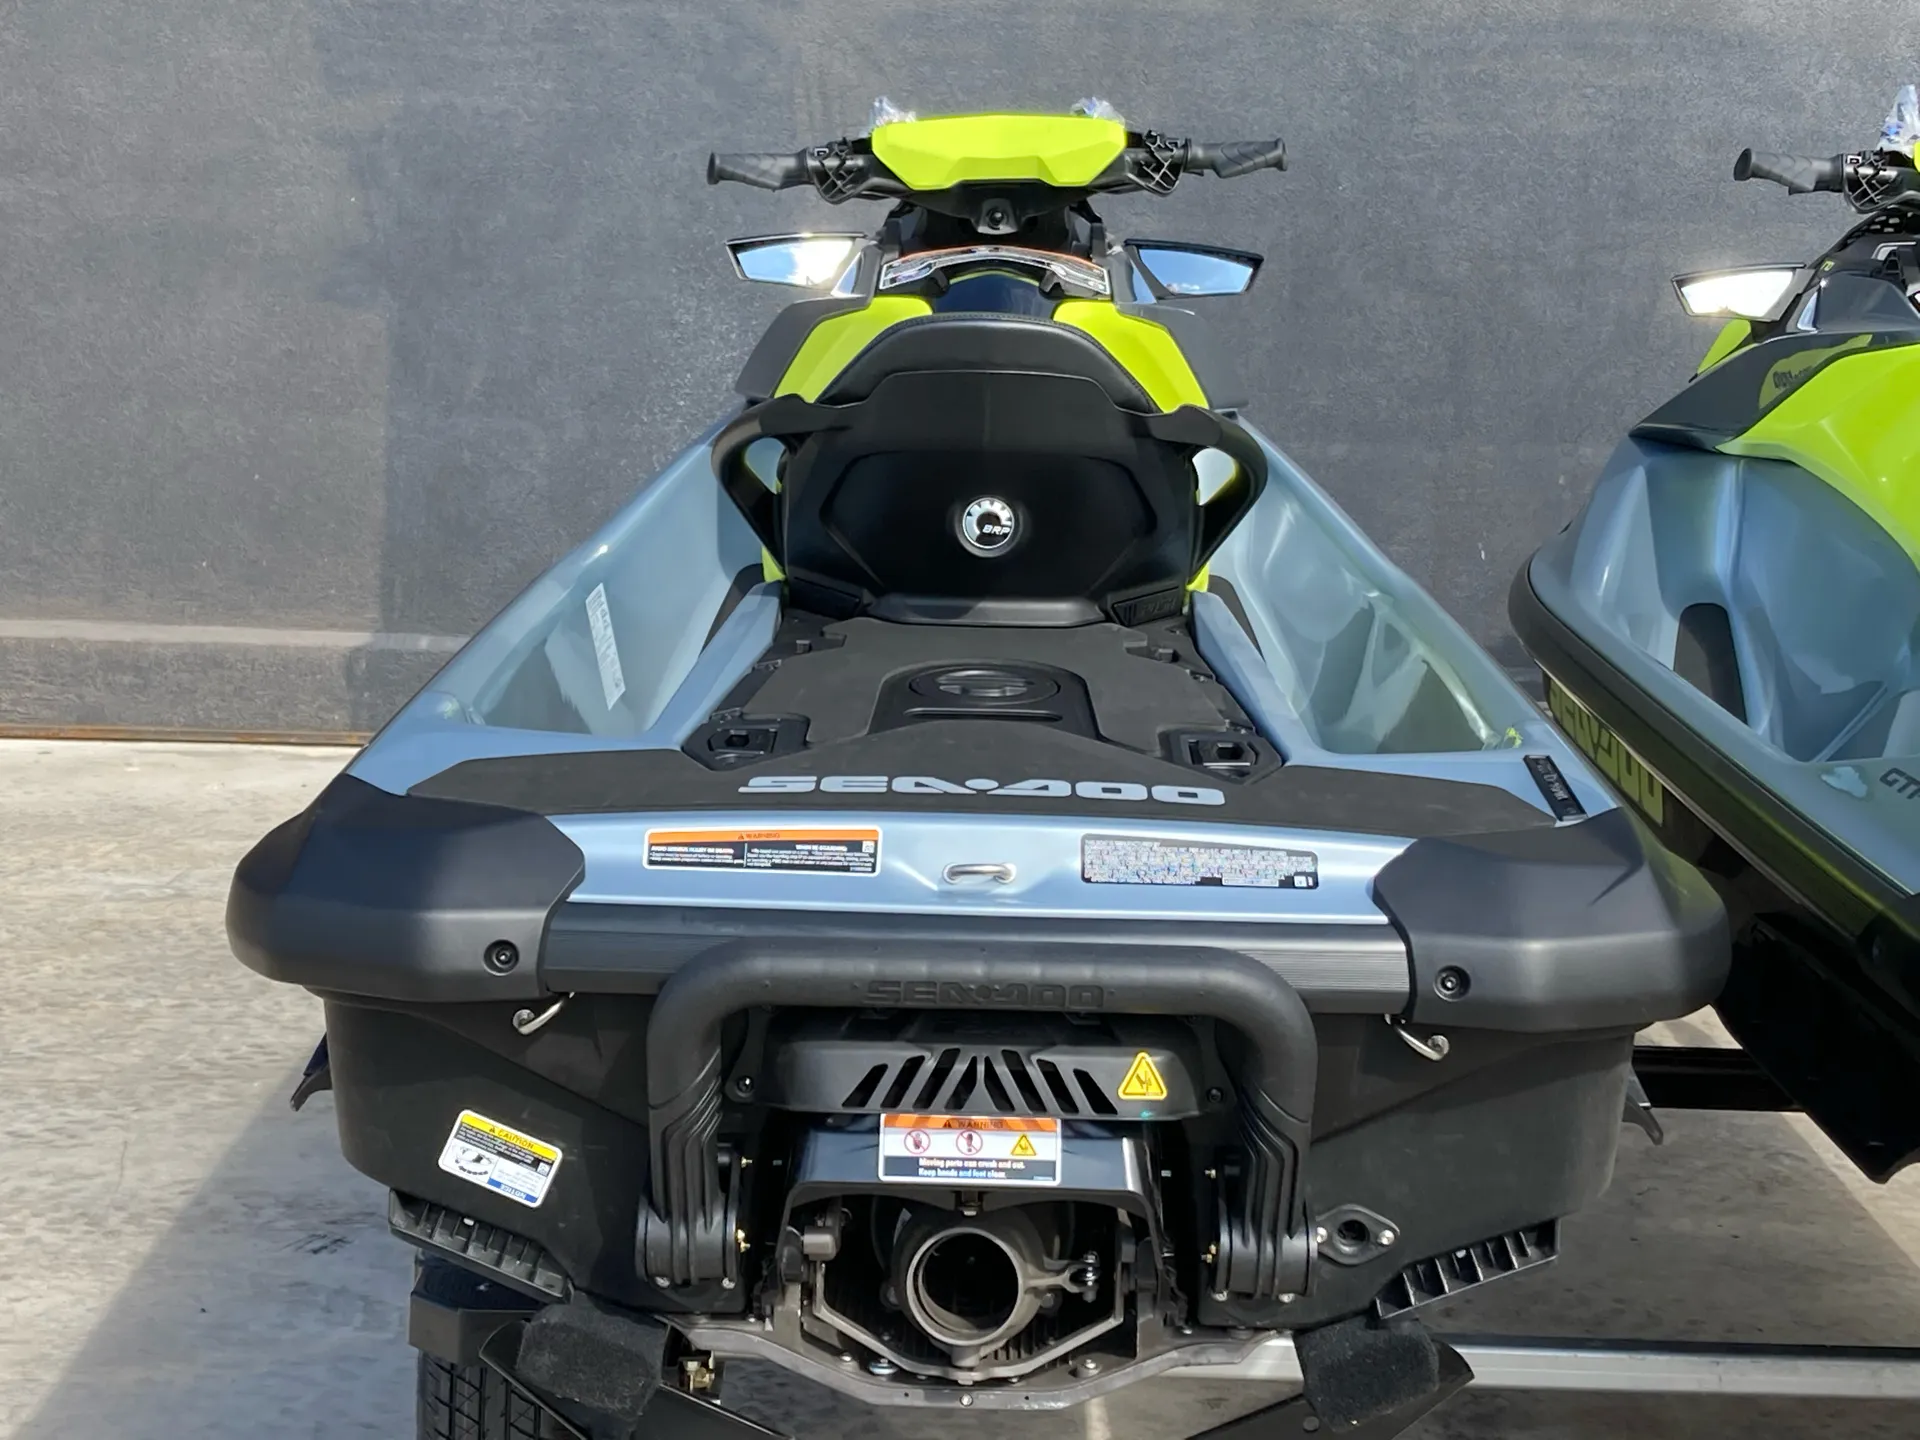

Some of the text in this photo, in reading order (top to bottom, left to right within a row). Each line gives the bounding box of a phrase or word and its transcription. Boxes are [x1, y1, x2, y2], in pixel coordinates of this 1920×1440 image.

[982, 524, 1011, 536] BRP
[958, 1119, 1004, 1129] WARNING
[497, 1127, 535, 1150] CAUTION
[919, 1158, 945, 1168] Moving
[945, 1159, 963, 1169] parts
[999, 1161, 1011, 1169] and
[919, 1168, 936, 1177] Keep
[937, 1168, 958, 1177] hands
[959, 1169, 972, 1177] and
